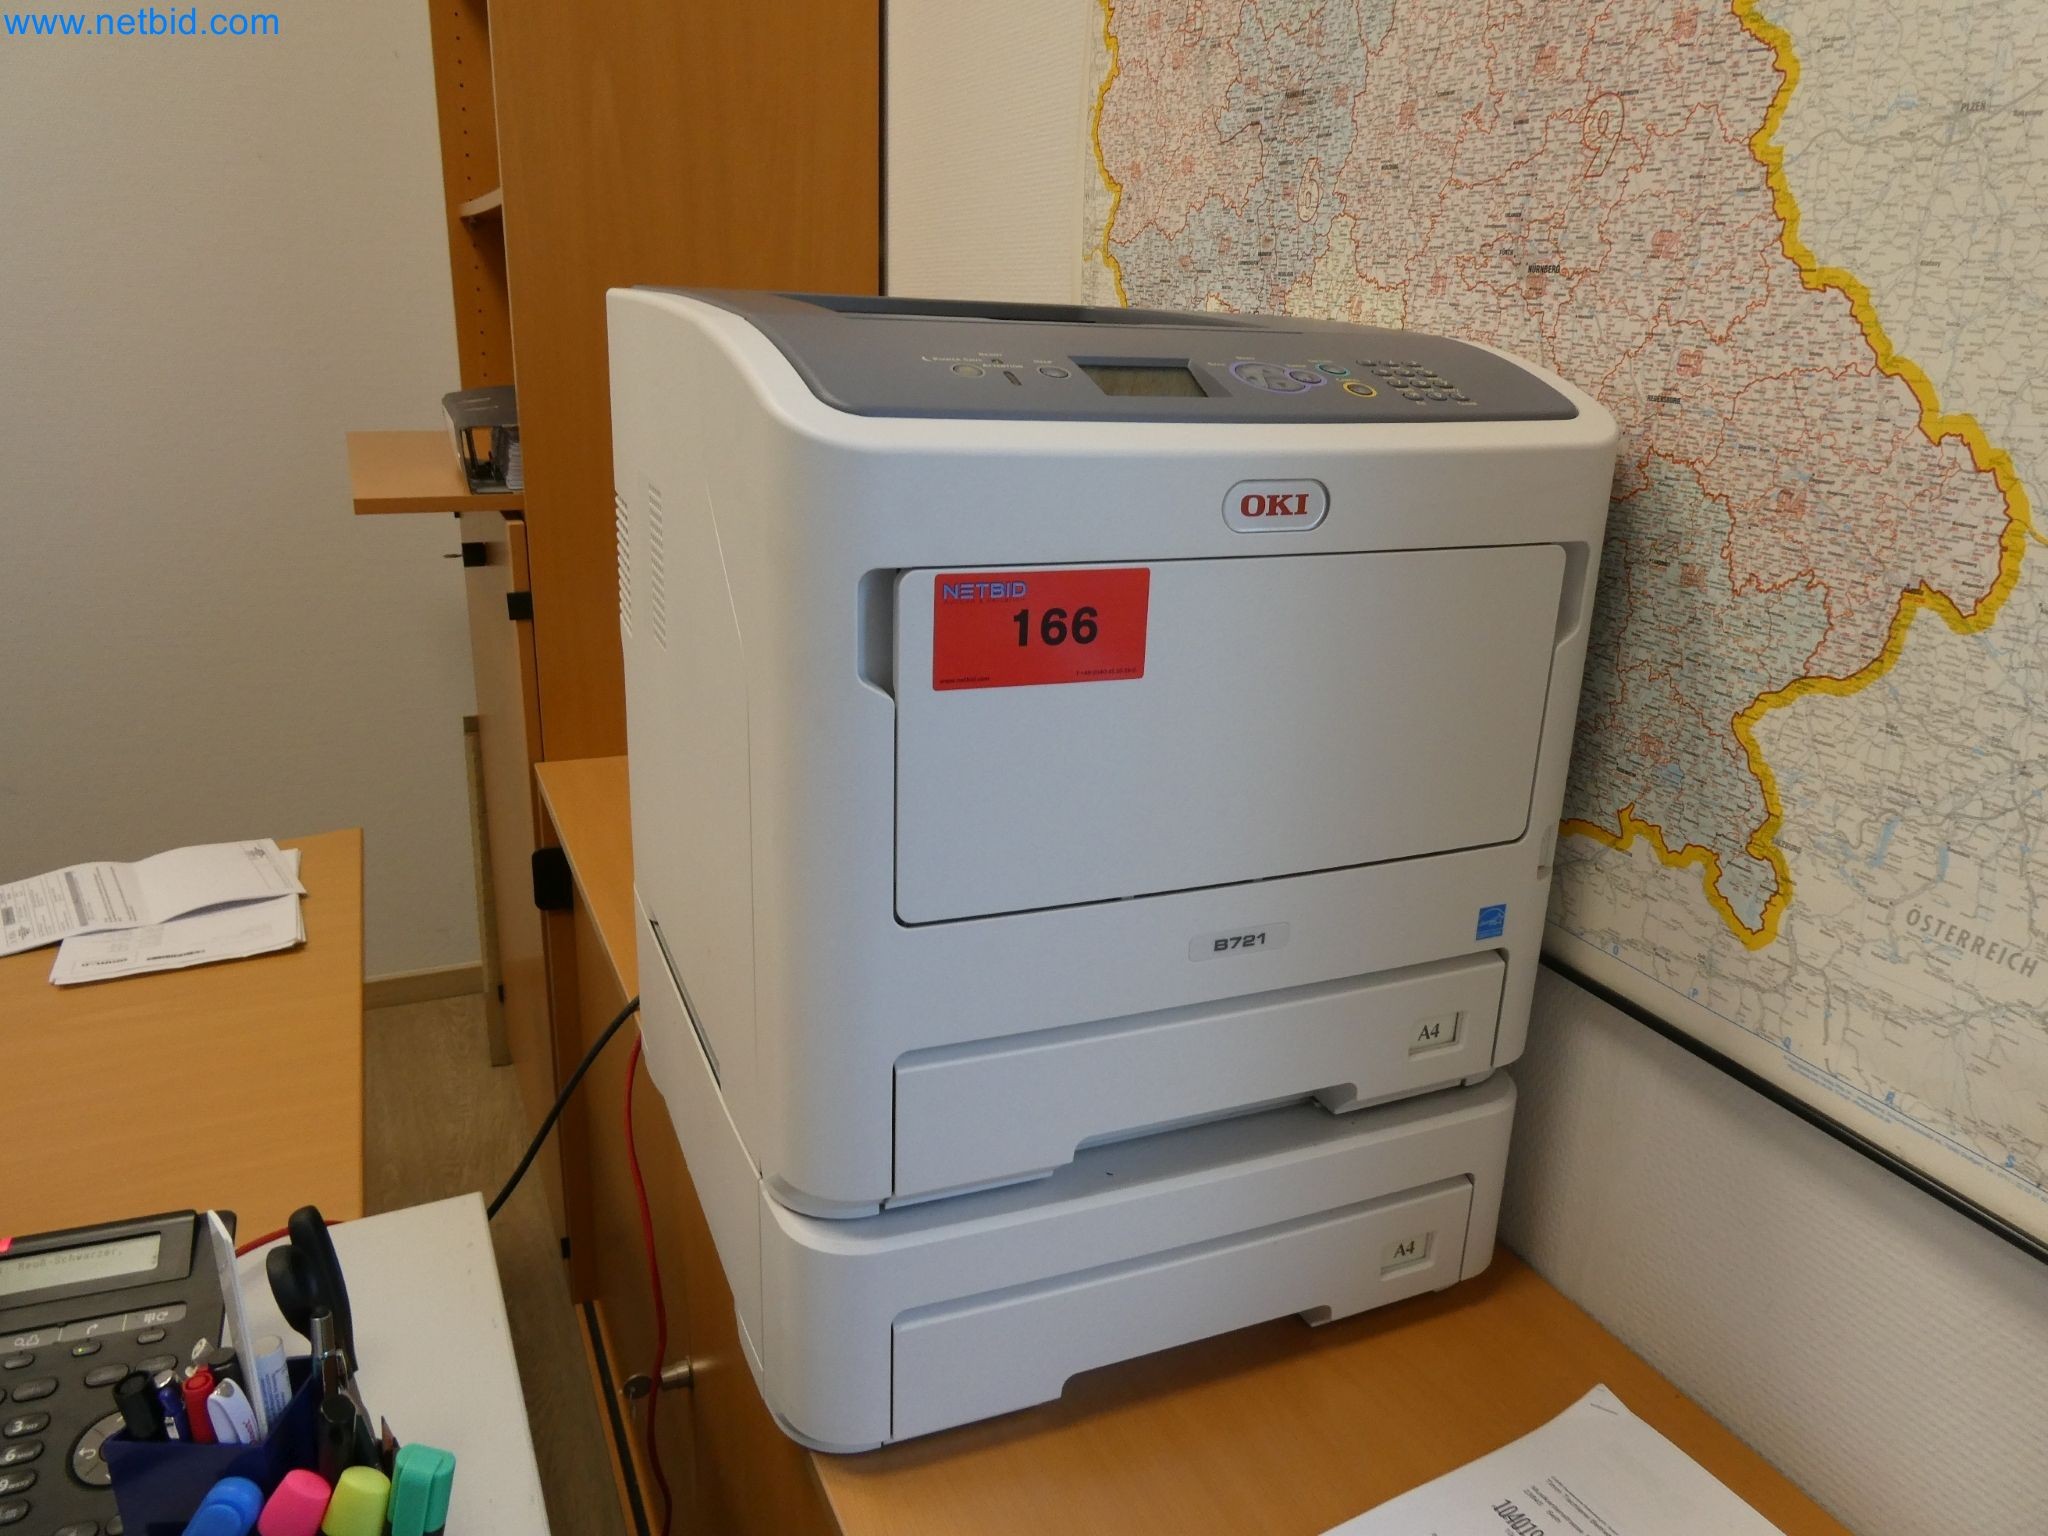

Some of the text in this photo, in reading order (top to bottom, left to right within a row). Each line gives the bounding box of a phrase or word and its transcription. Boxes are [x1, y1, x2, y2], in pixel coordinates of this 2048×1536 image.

[1527, 264, 1561, 274] NÜRNBERG
[1240, 493, 1310, 518] OKI
[943, 582, 1028, 600] NETBID
[1013, 606, 1099, 647] 166
[1213, 932, 1267, 952] B721
[1906, 903, 2039, 979] ÖSTERREICH
[1417, 1023, 1441, 1042] A4
[1393, 1241, 1417, 1258] A4
